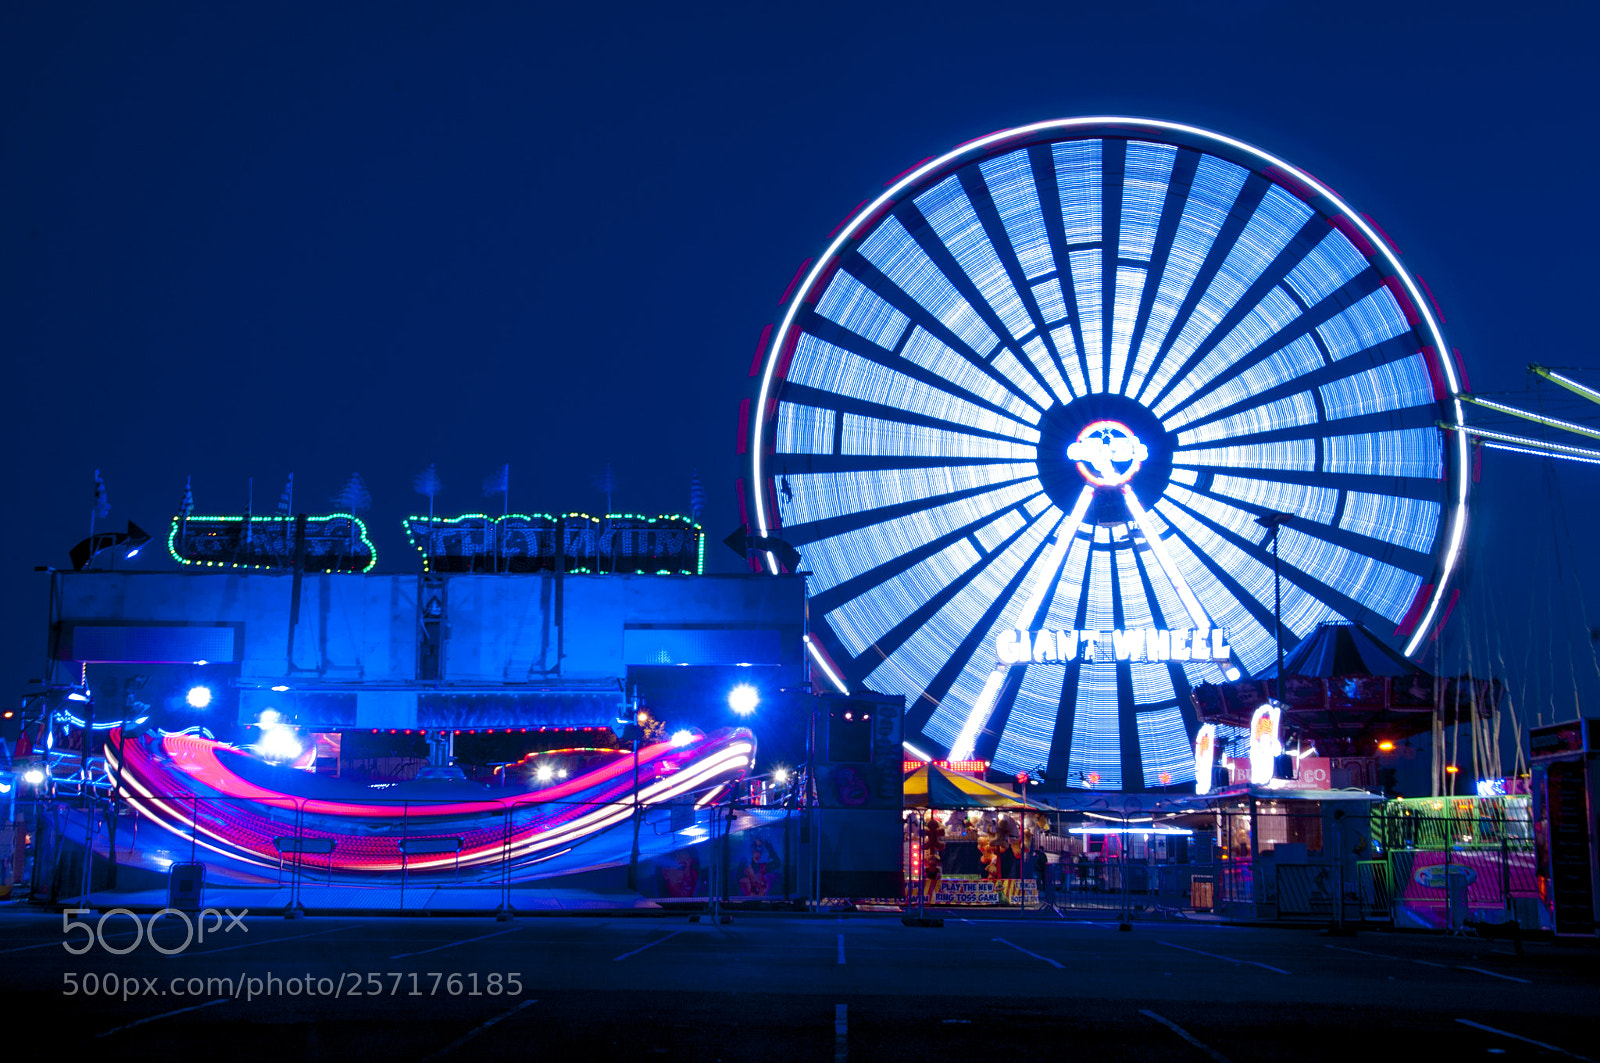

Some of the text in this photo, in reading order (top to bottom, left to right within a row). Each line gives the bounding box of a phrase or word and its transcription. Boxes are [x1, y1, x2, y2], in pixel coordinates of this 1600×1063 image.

[995, 627, 1231, 664] GIANT WHEEL
[941, 882, 994, 893] PLAY THE NEW
[935, 893, 999, 904] RING TOSS GAME
